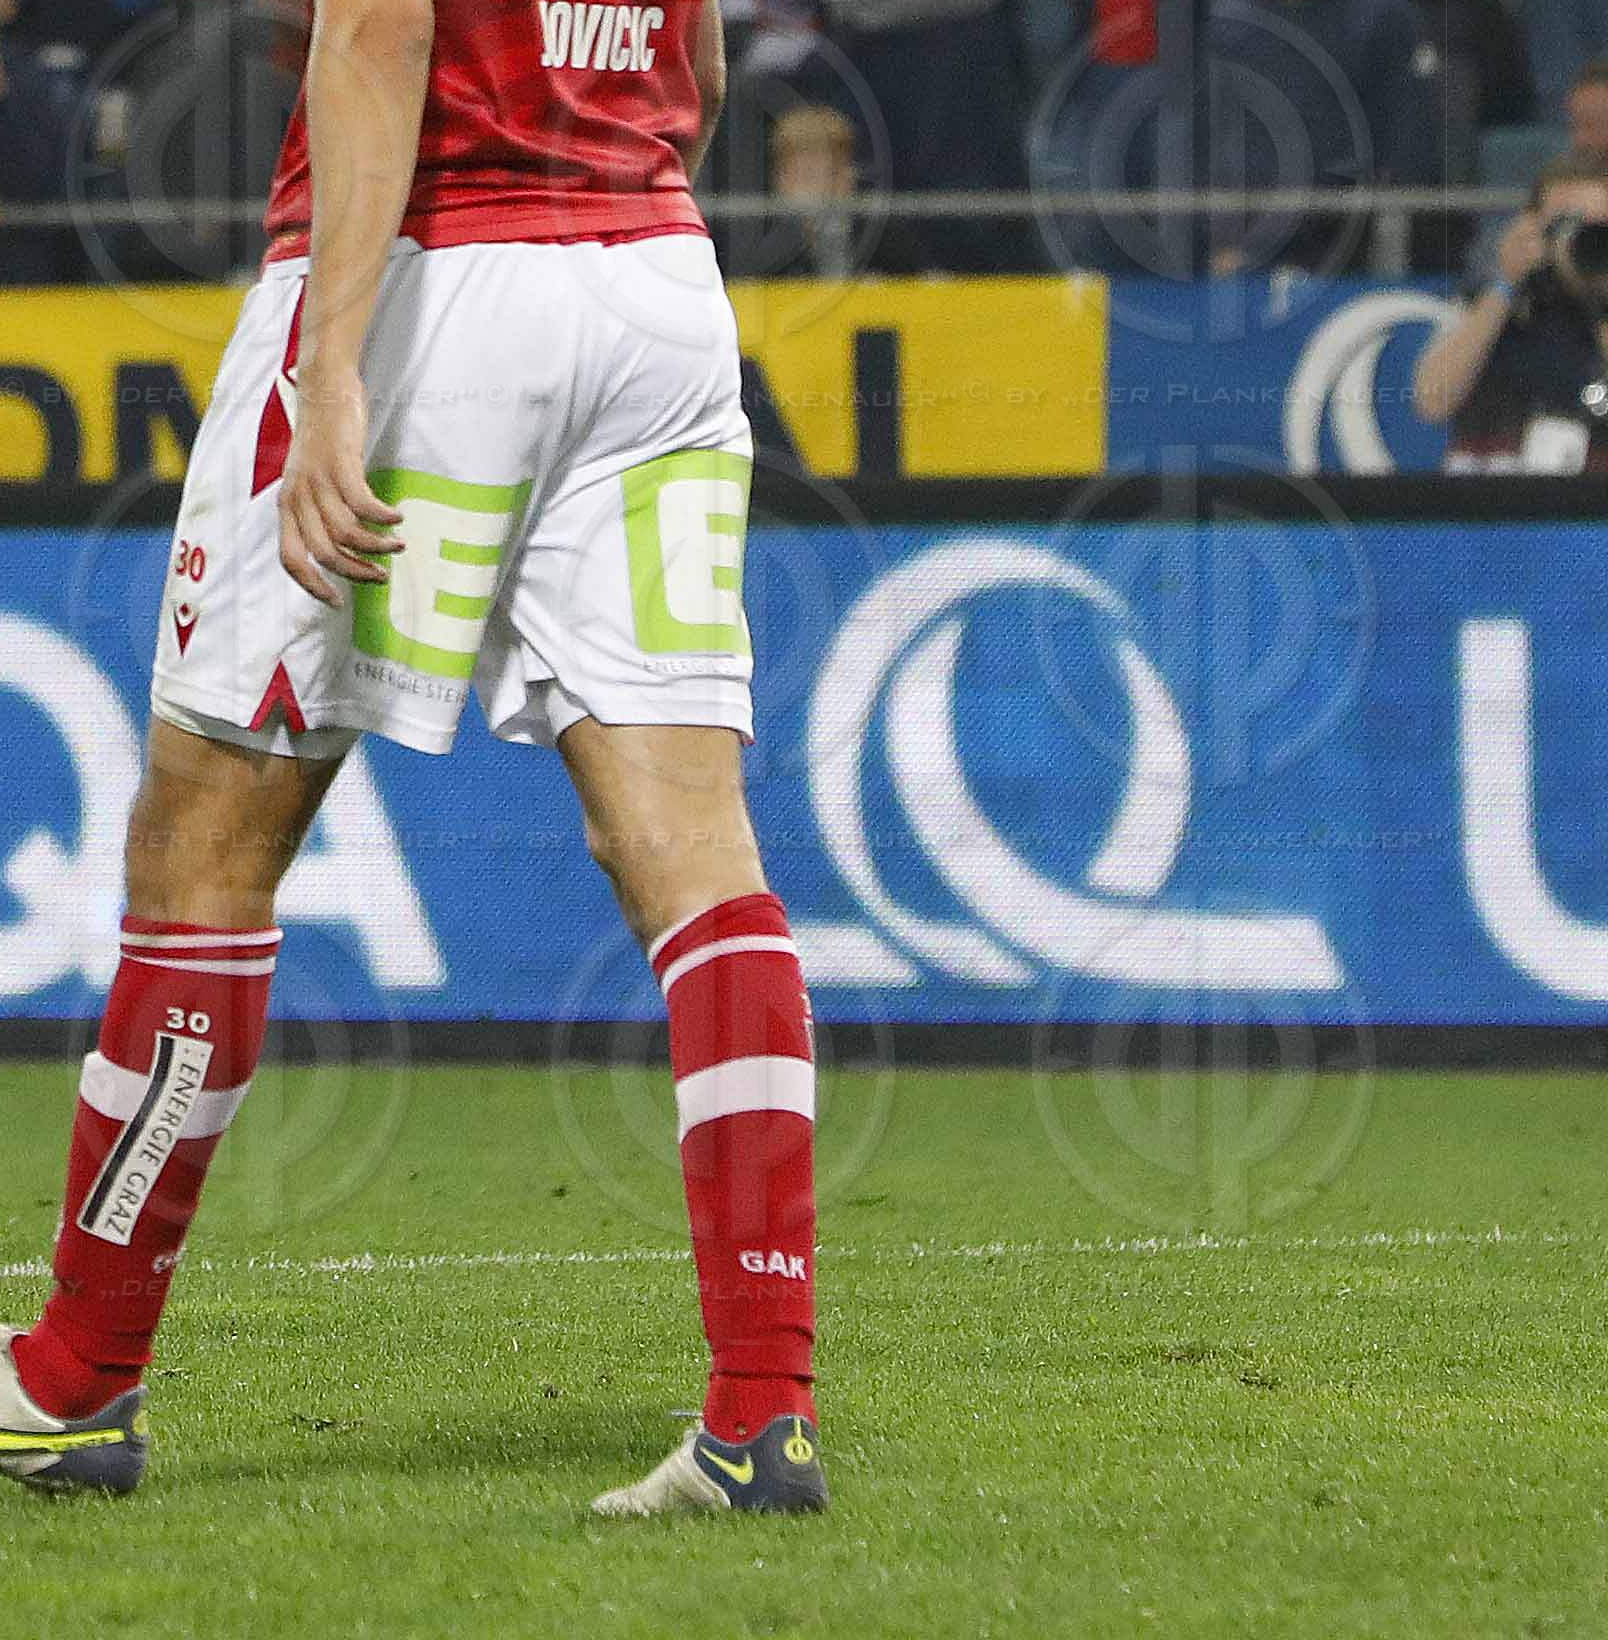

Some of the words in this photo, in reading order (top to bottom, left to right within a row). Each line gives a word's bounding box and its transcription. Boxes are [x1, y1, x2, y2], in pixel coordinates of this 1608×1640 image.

[175, 539, 206, 582] 30
[166, 1007, 211, 1034] 30
[138, 1061, 200, 1168] ENERGIE
[103, 1171, 149, 1238] GRAZ
